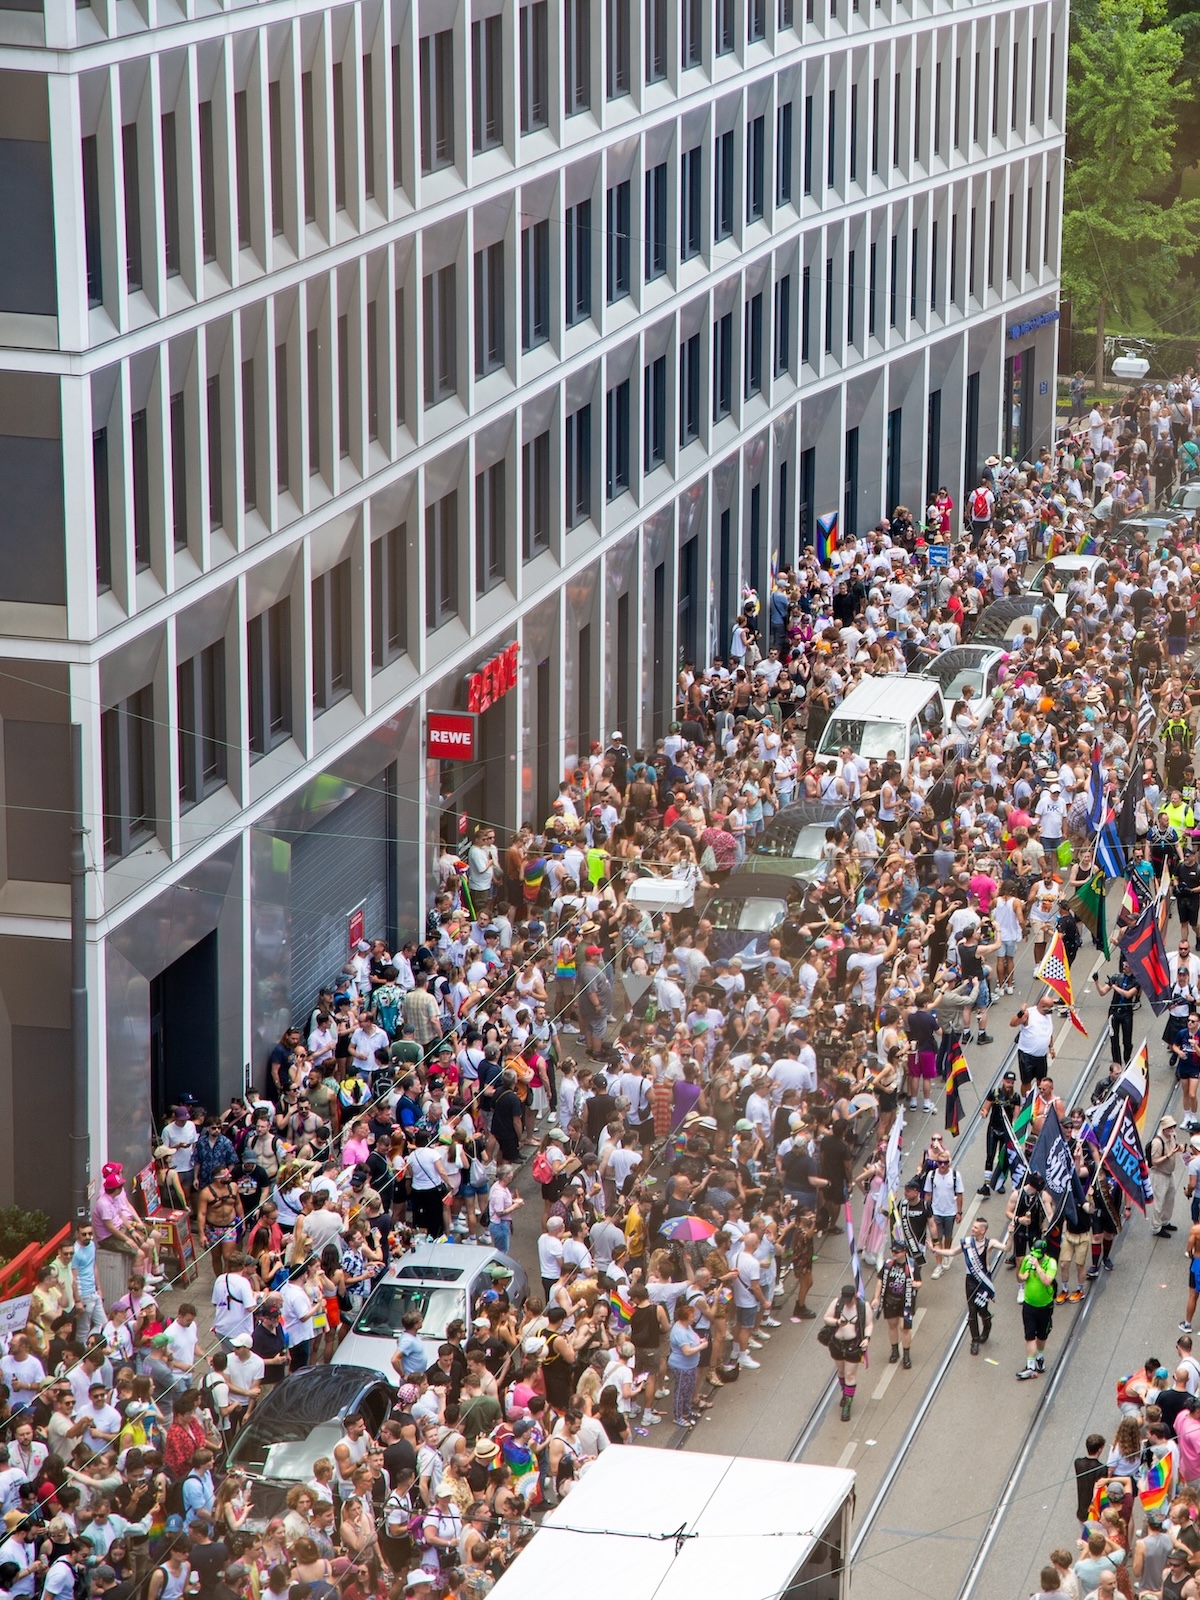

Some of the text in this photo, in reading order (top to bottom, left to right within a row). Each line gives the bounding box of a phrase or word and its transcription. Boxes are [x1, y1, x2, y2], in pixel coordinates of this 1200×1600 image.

[467, 640, 519, 714] REWE
[430, 730, 471, 745] REWE
[1047, 804, 1060, 812] MK
[905, 1278, 913, 1307] EUROPE
